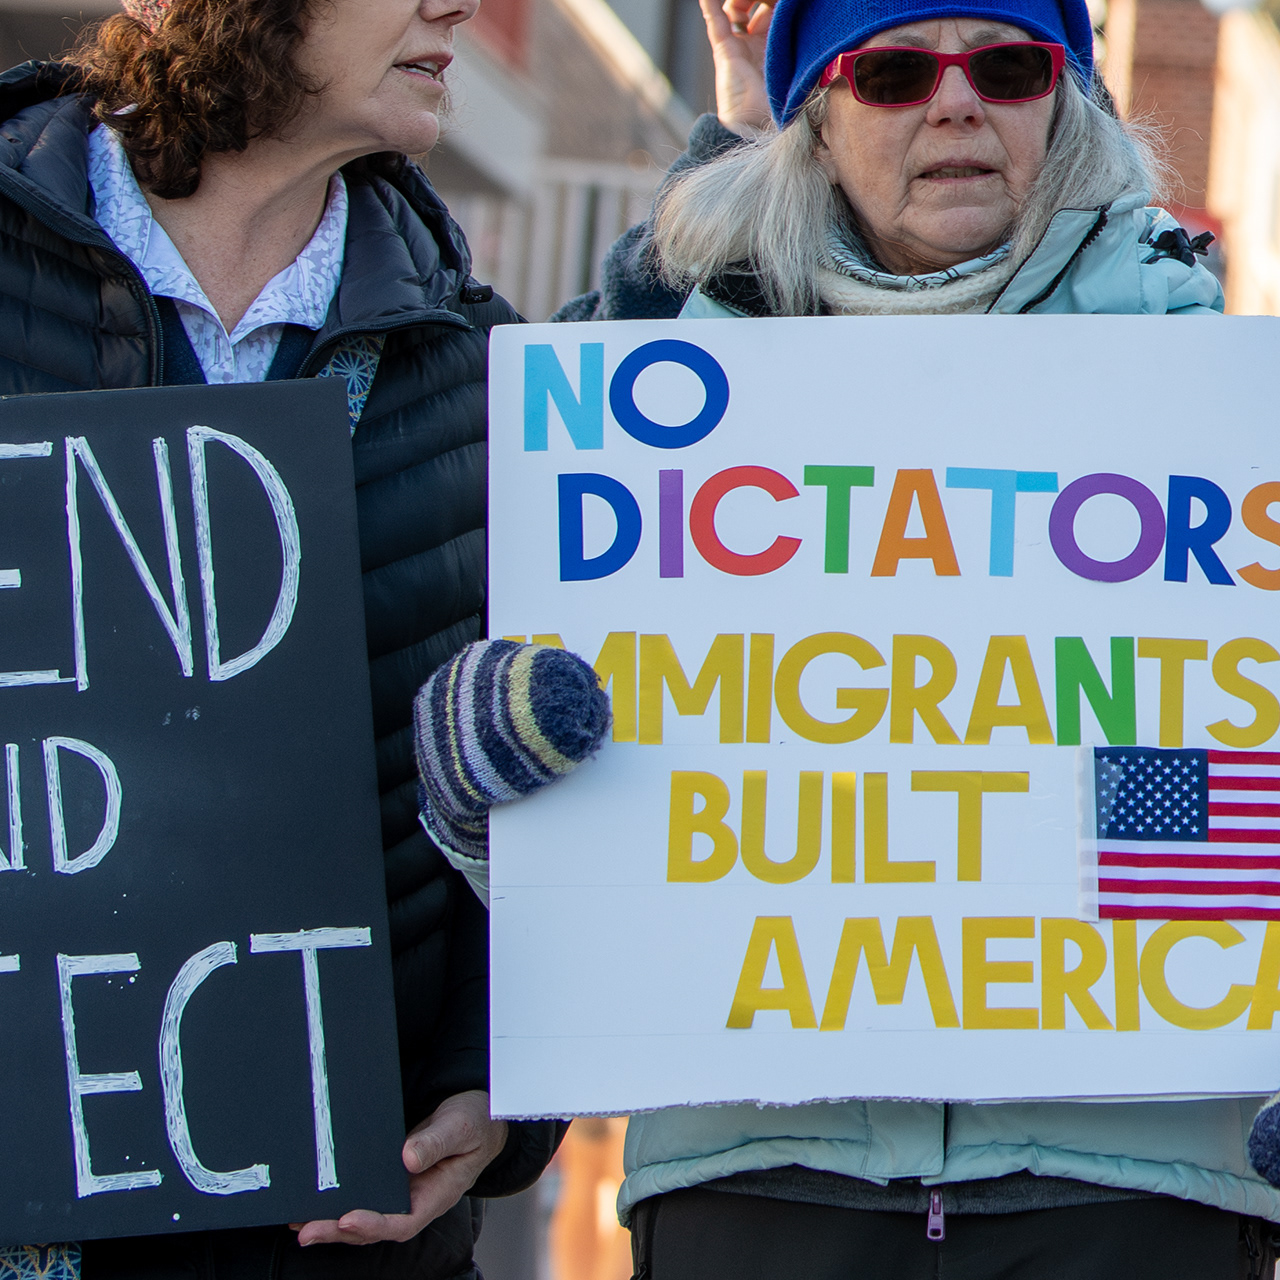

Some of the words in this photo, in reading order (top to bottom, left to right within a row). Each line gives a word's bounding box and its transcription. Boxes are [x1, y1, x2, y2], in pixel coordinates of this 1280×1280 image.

[523, 338, 730, 452] NO
[666, 769, 1030, 884] BUILT
[0, 926, 373, 1199] ECT
